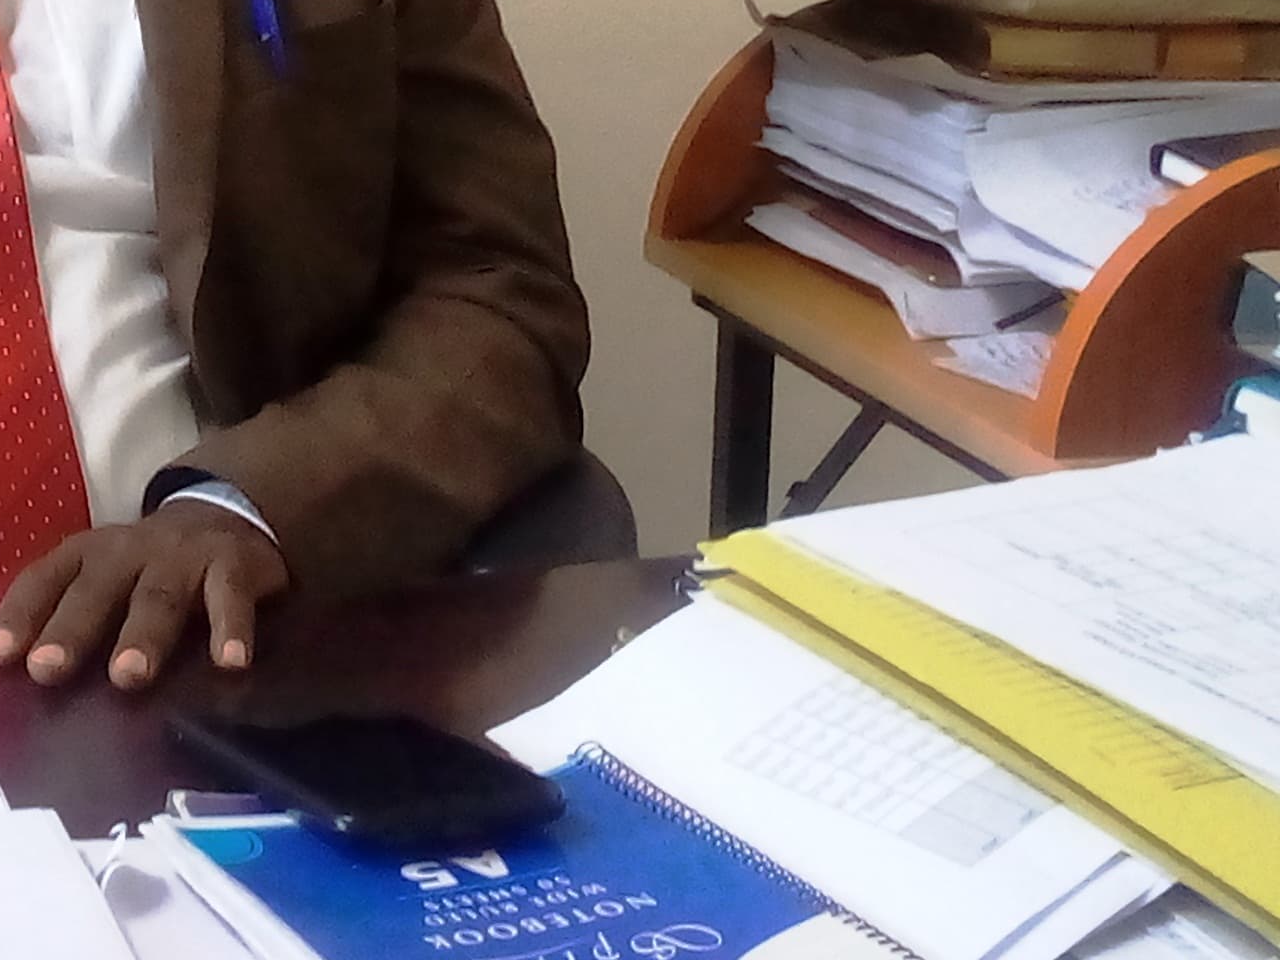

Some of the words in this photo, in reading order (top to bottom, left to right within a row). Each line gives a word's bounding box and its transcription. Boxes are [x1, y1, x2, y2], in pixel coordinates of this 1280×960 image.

[401, 849, 510, 890] A5
[423, 884, 527, 912] SHEETS
[528, 882, 607, 907] WIDE
[423, 901, 519, 926] RULED
[423, 891, 658, 950] NOTEBOOK
